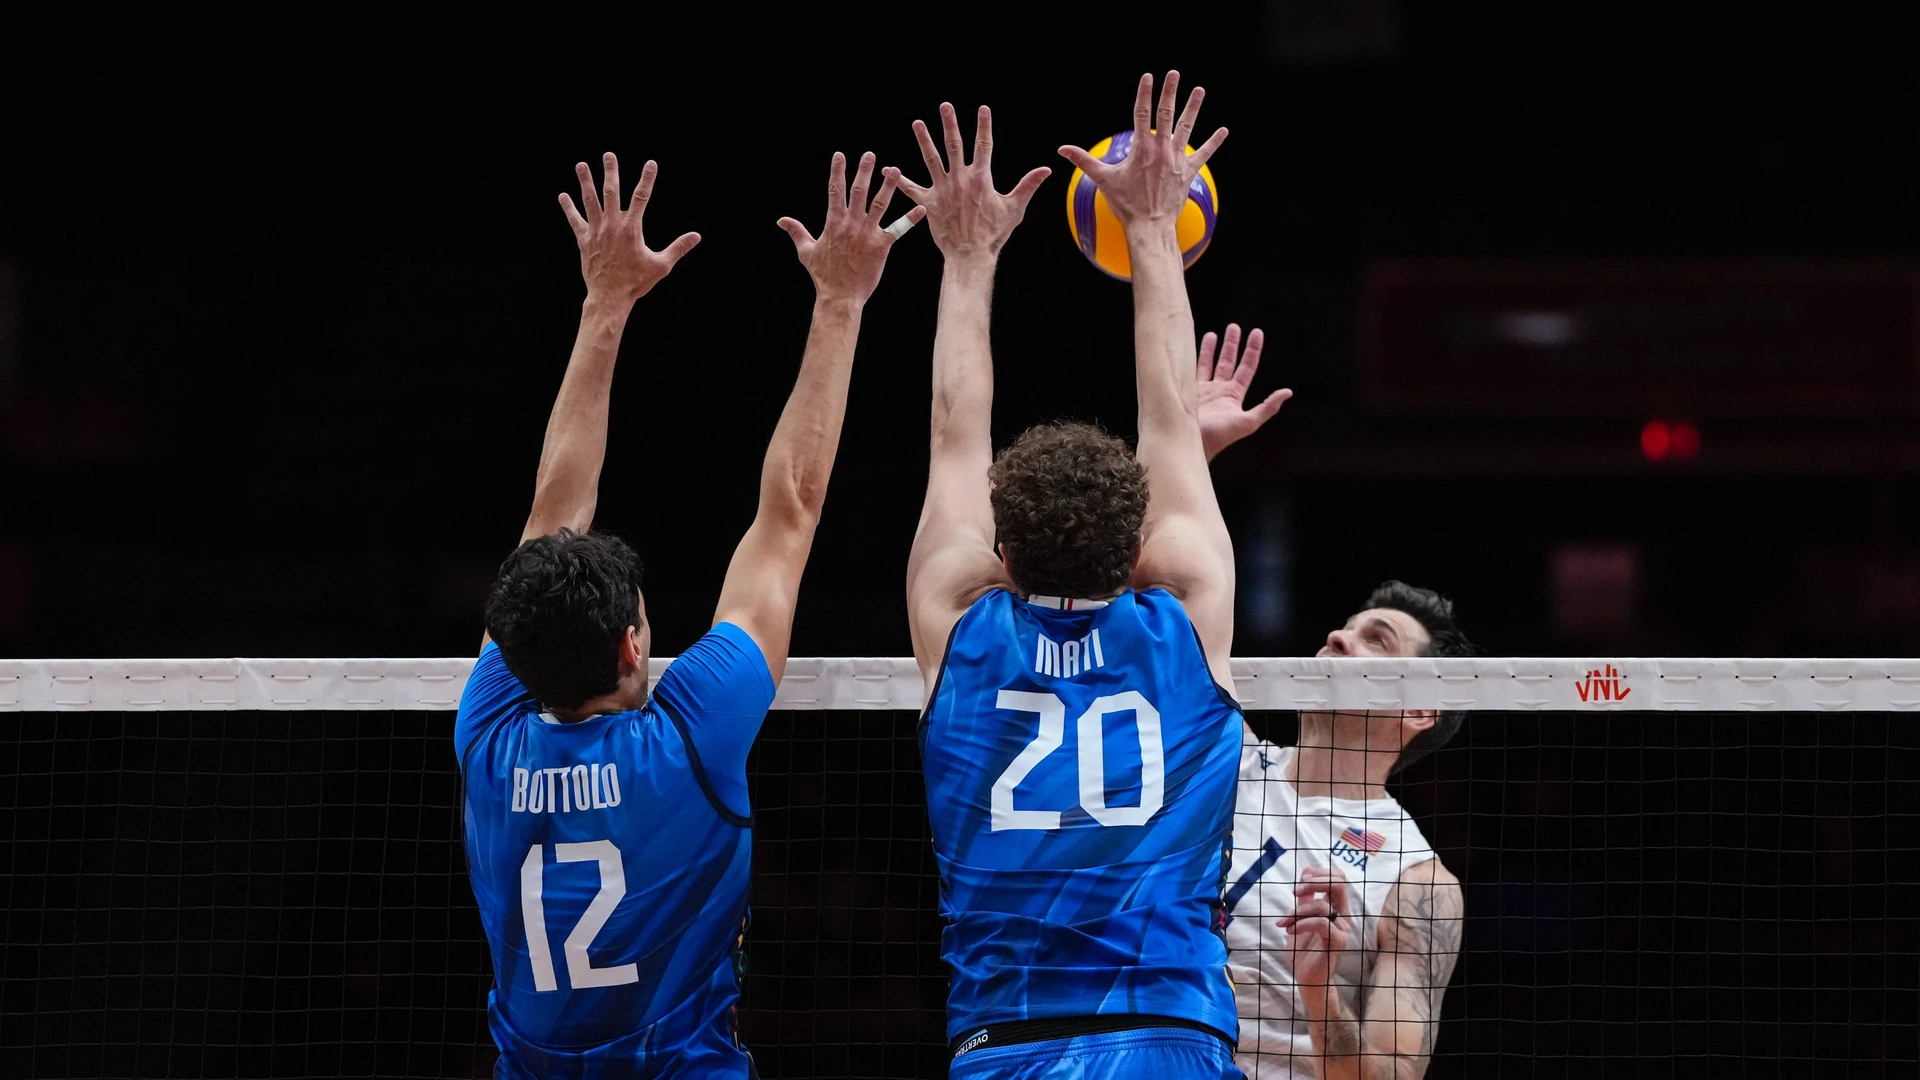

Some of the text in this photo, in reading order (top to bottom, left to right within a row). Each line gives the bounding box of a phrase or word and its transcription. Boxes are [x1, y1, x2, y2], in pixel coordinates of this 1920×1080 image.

[1035, 628, 1104, 678] MATI
[1575, 664, 1631, 702] VNL
[990, 690, 1165, 832] 20
[511, 763, 621, 813] BOTTOLO
[1331, 840, 1369, 871] USA
[520, 839, 639, 992] 12
